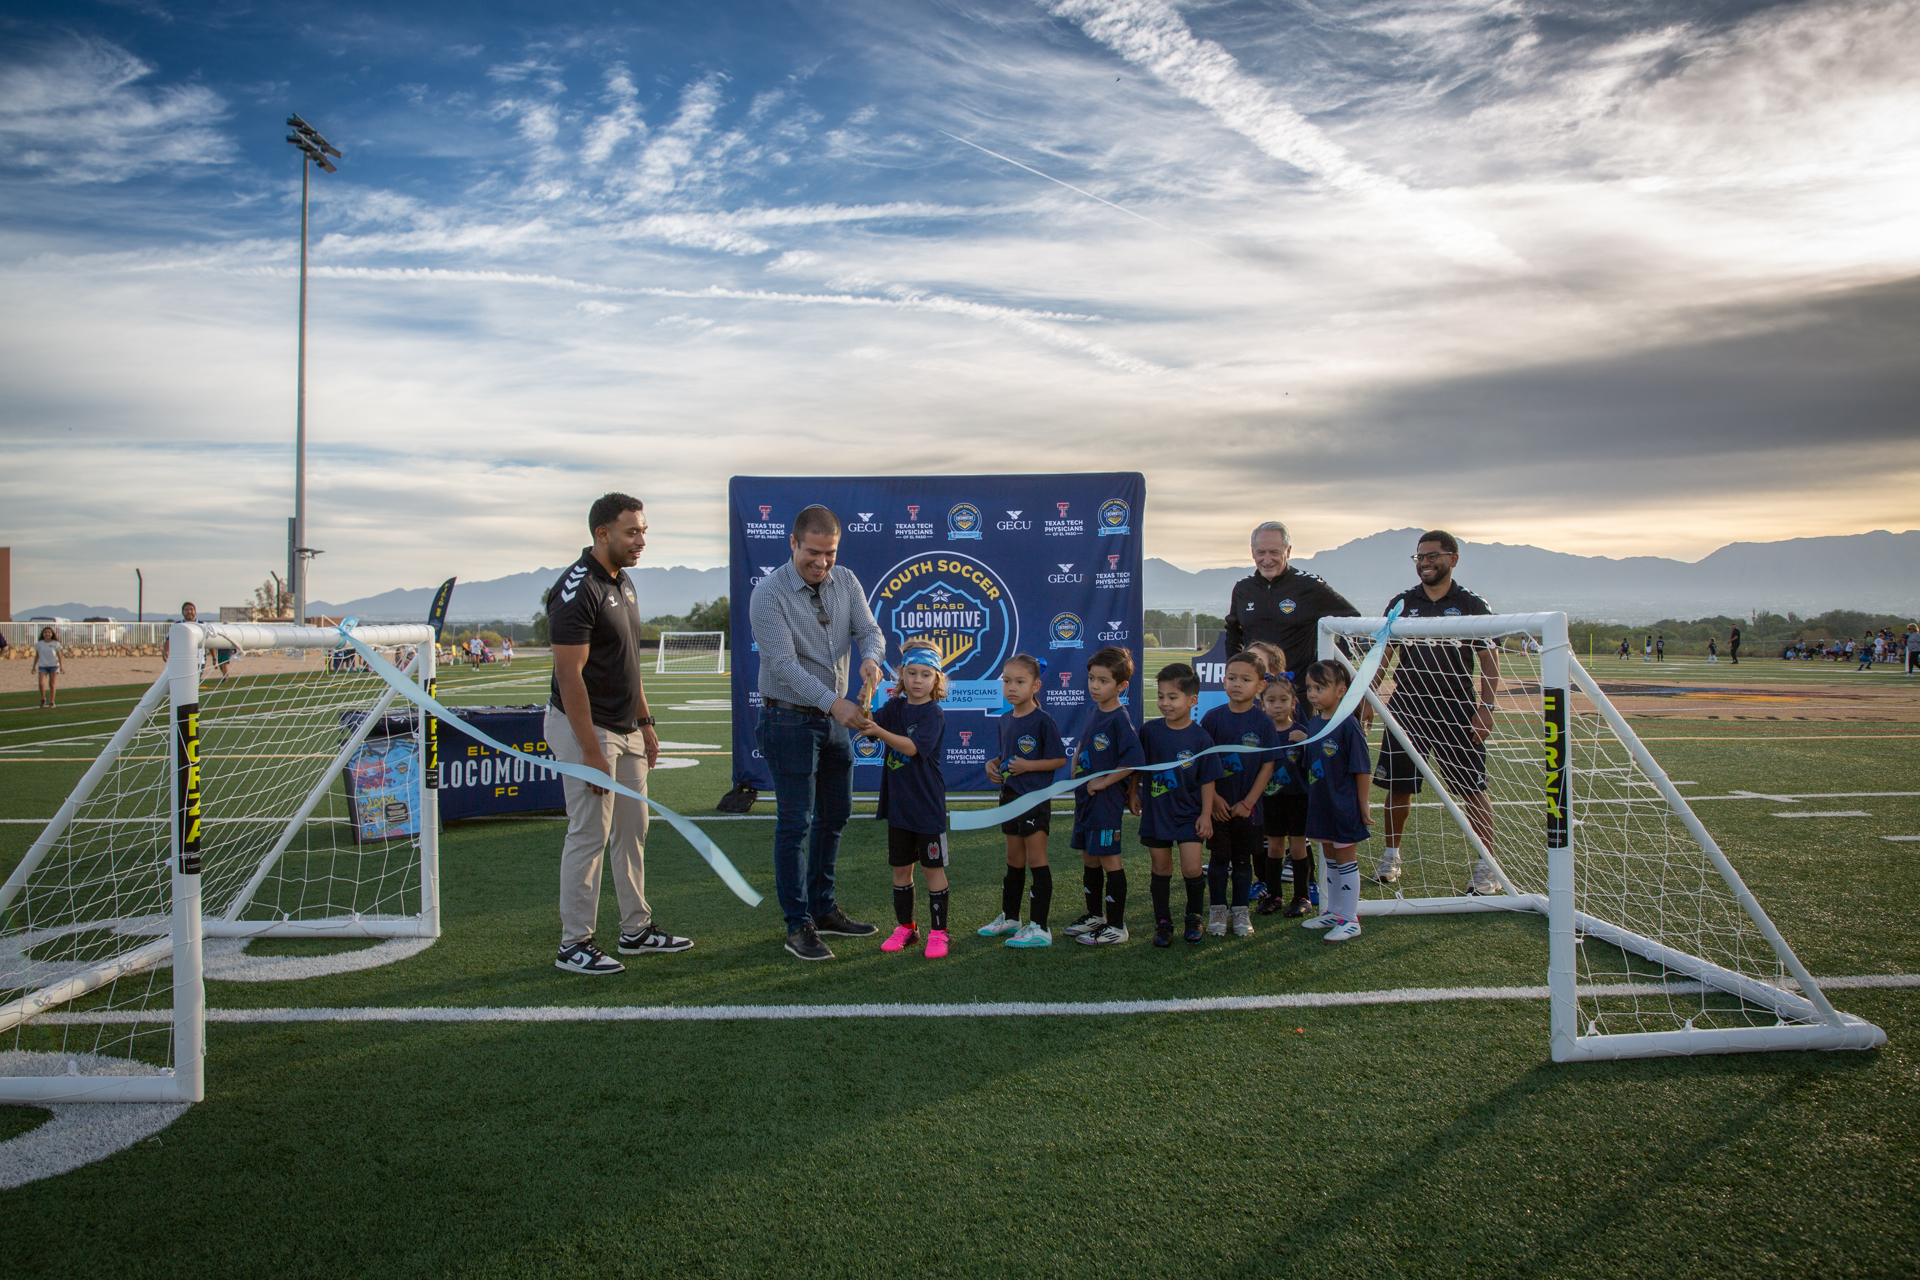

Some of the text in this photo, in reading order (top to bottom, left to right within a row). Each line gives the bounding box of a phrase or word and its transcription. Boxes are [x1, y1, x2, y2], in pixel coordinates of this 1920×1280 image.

[848, 523, 882, 532] GECU
[996, 521, 1031, 530] GECU
[750, 577, 762, 586] GE
[880, 559, 1000, 600] YOUTH SOCCER
[1048, 573, 1083, 584] GECU
[900, 611, 981, 628] LOCOMOTIVE
[1098, 631, 1128, 641] GECU
[1196, 662, 1226, 684] FIR
[468, 742, 548, 756] EL ASO
[1545, 696, 1563, 818] FORZA
[438, 754, 558, 789] LOCOMOTIV
[495, 786, 519, 797] FC
